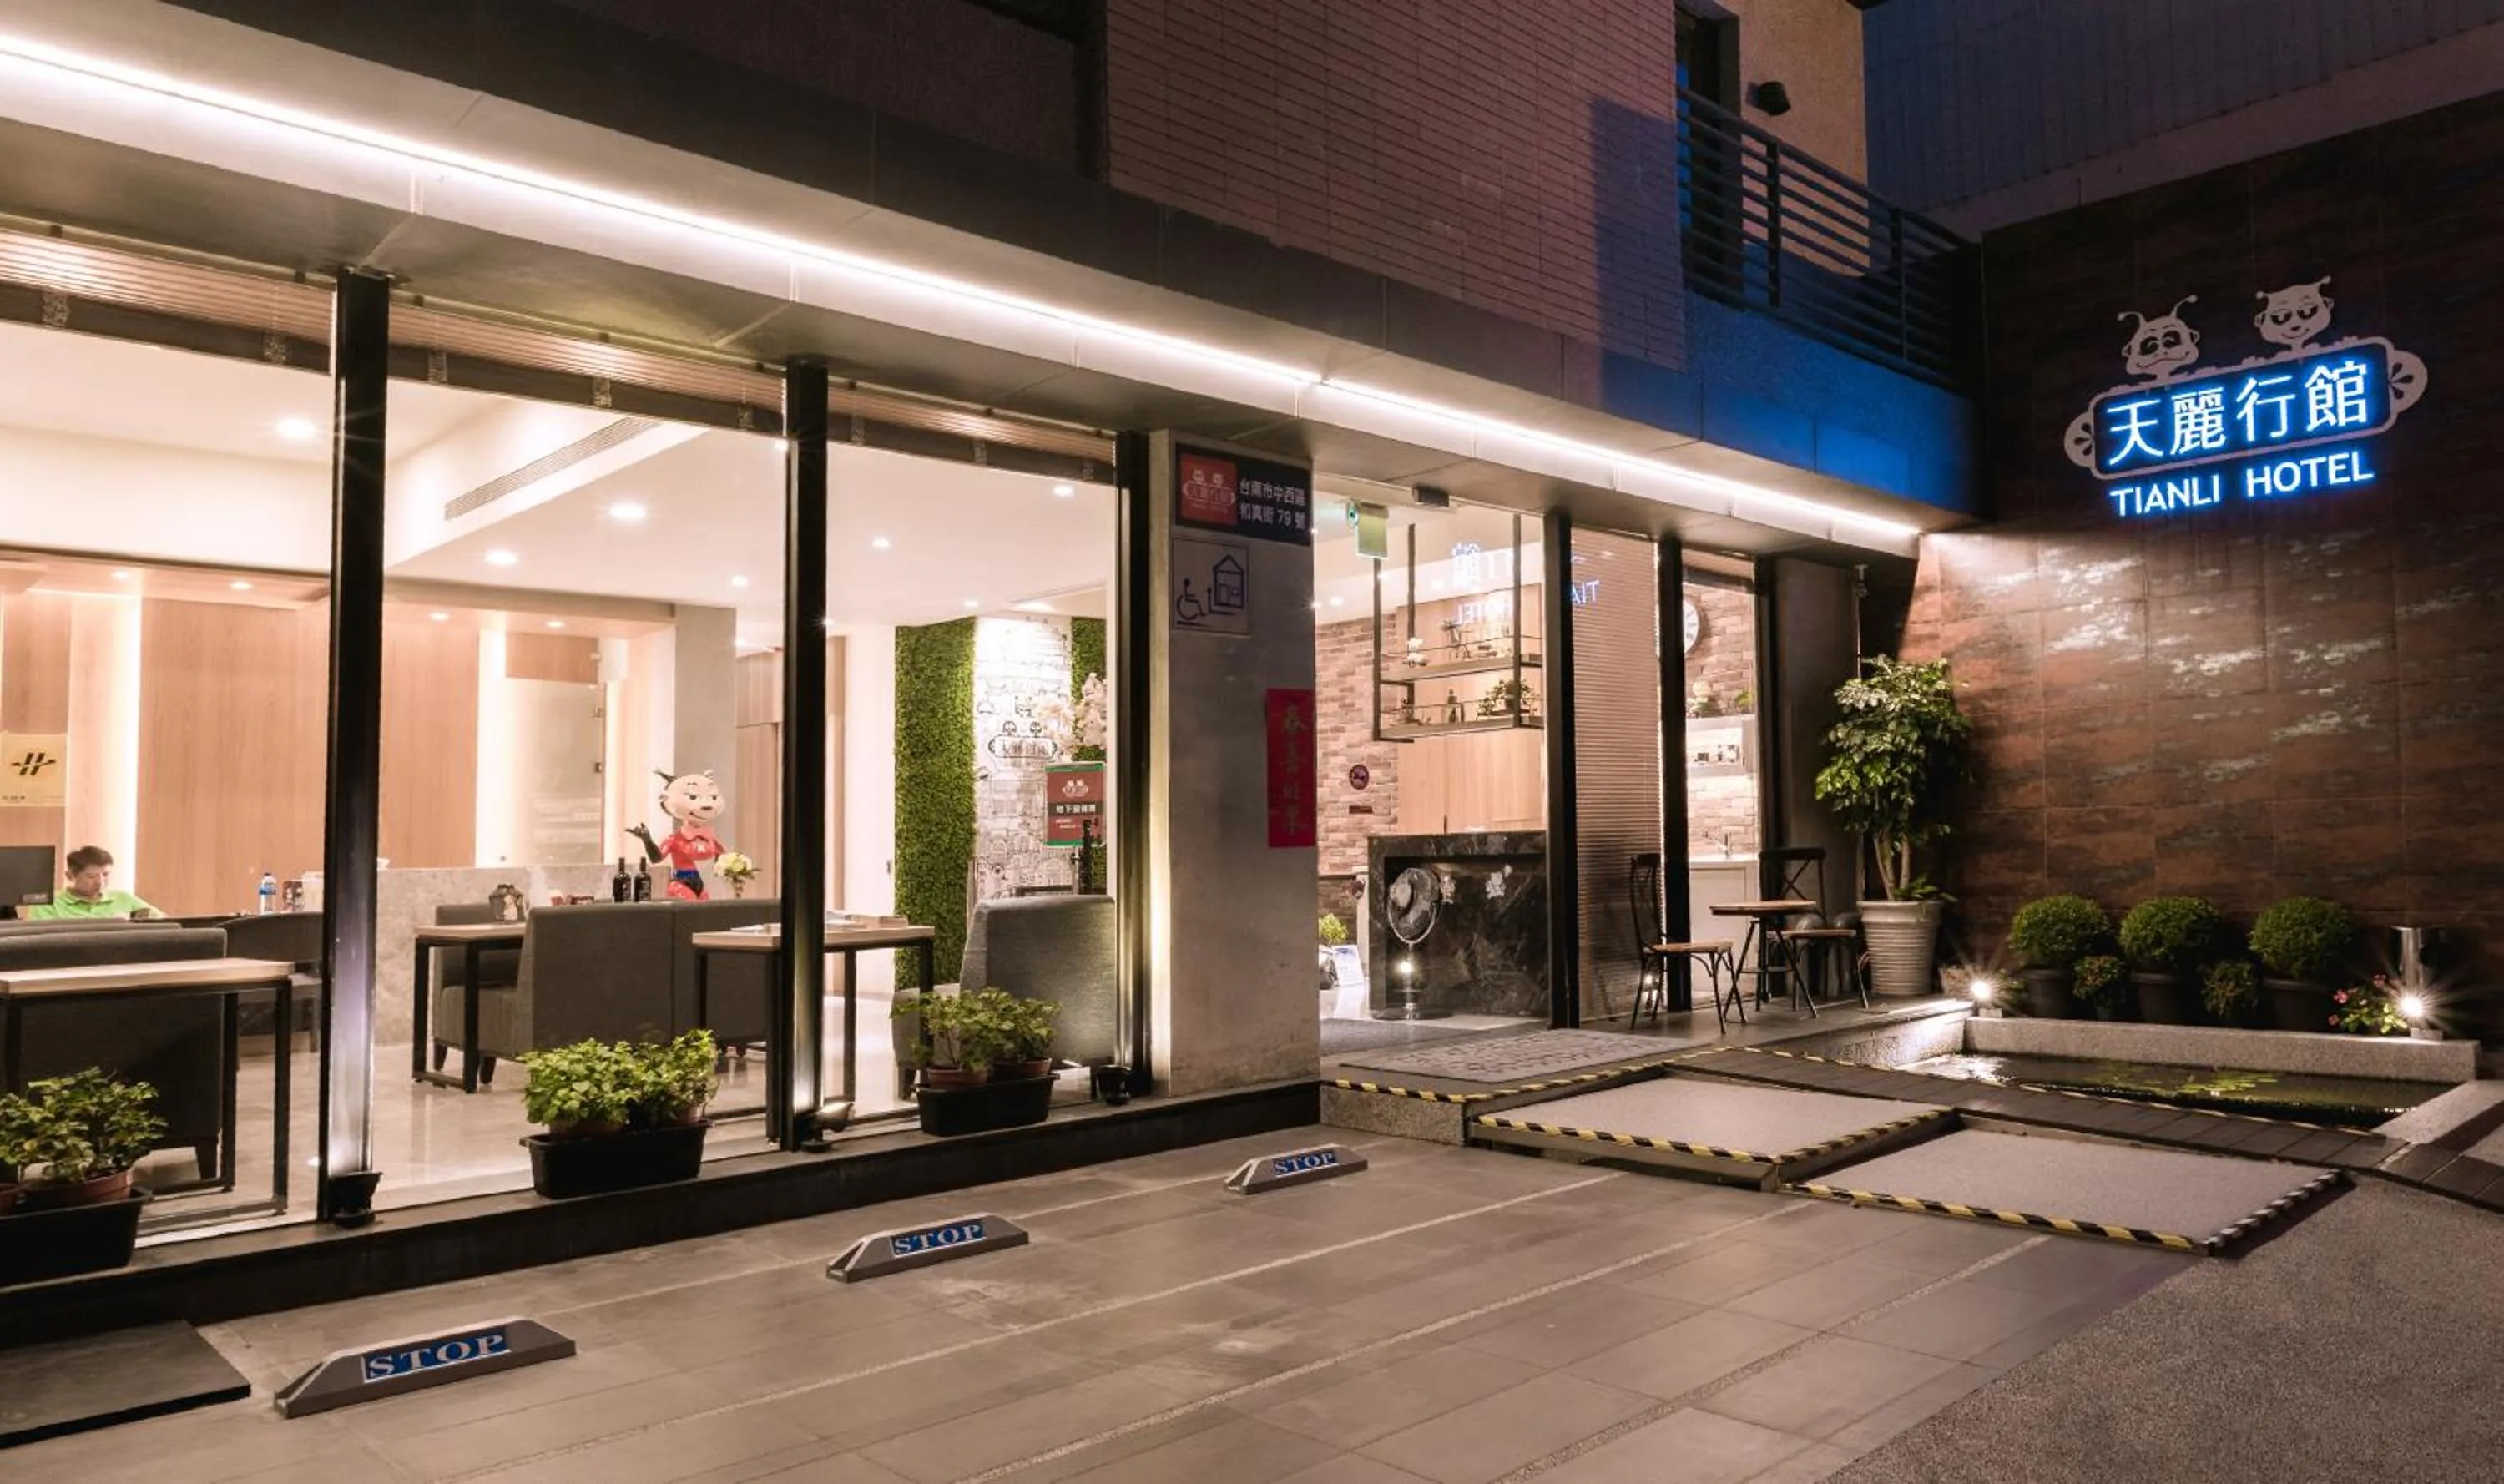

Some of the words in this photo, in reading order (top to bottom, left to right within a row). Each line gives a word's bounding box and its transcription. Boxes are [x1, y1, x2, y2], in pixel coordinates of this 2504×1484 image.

[2105, 359, 2369, 467] 天麗行館
[2109, 474, 2220, 517] TIANLI
[2247, 451, 2375, 497] HOTEL
[1275, 1153, 1333, 1174] STOP
[895, 1224, 981, 1253] STOP
[369, 1335, 503, 1377] STOP
